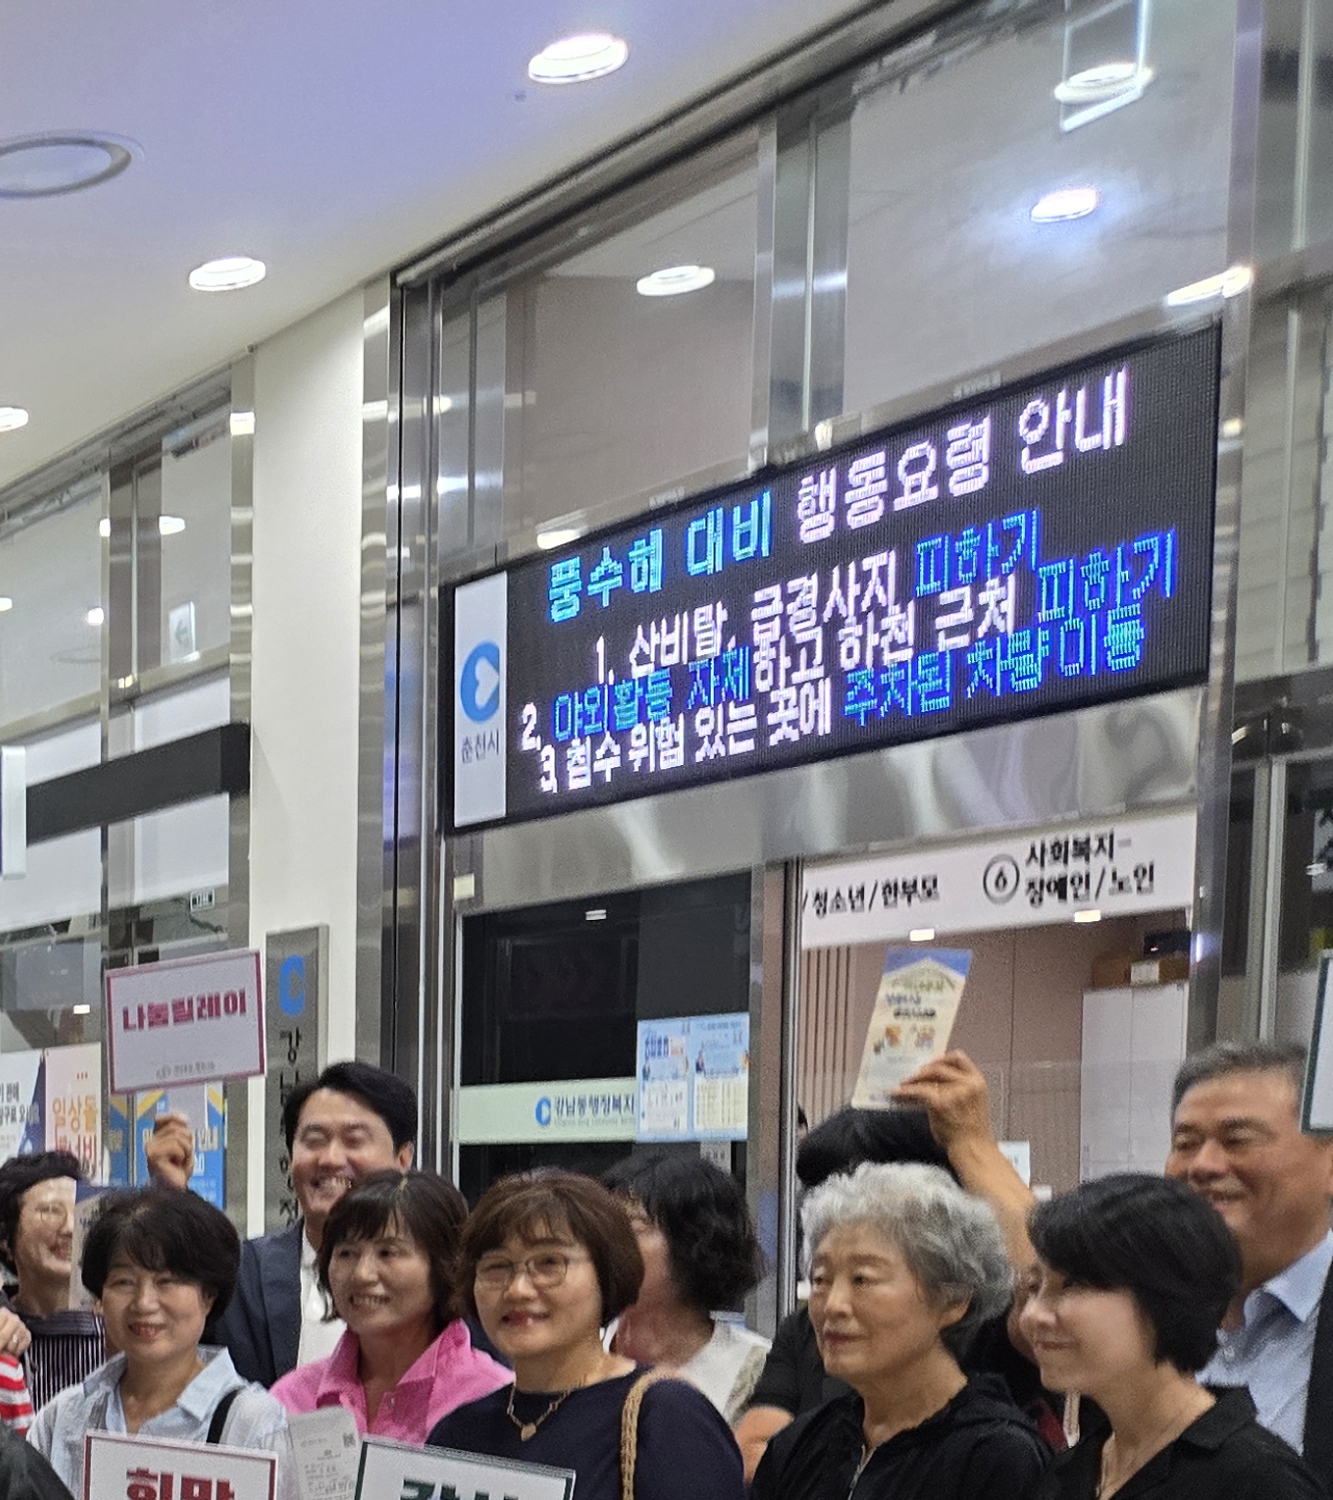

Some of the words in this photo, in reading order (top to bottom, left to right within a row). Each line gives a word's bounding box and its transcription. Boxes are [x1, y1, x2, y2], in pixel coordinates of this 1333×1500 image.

[547, 528, 664, 623] 풍수해
[686, 489, 771, 577] 대비
[796, 415, 992, 545] 행동요령
[1018, 366, 1128, 475] 안내
[915, 507, 1041, 598] 피하기
[553, 666, 674, 743] 야외활동
[837, 599, 916, 677] 하천
[934, 572, 1016, 653] 근처
[1037, 529, 1176, 625] 피하기
[628, 711, 686, 773] 위험
[694, 700, 758, 762] 있는
[765, 676, 833, 748] 곳에
[843, 650, 952, 728] 주차된
[122, 986, 247, 1033] 나눔릴레이
